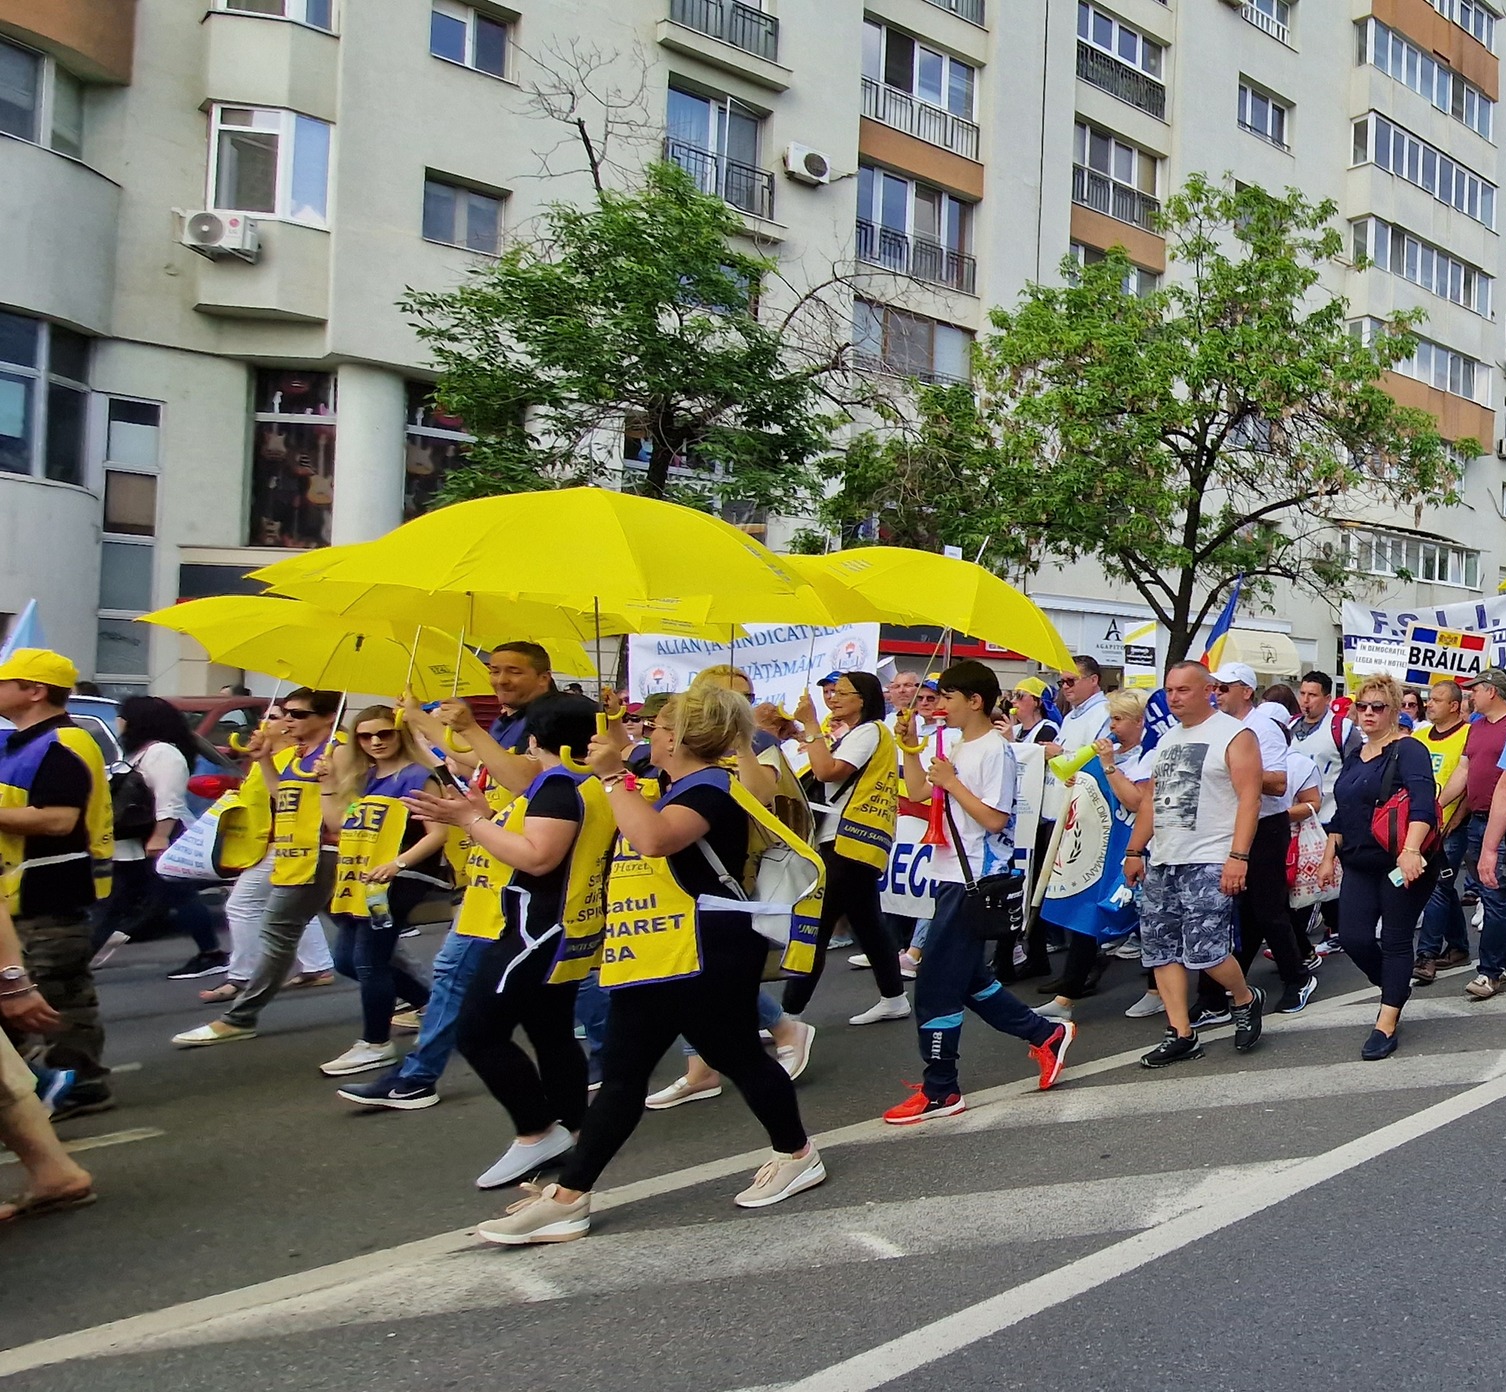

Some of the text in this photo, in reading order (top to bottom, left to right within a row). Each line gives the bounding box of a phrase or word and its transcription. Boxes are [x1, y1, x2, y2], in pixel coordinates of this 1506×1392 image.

[1408, 646, 1481, 675] BRĂILA
[275, 847, 312, 858] ARET
[604, 945, 637, 963] BA
